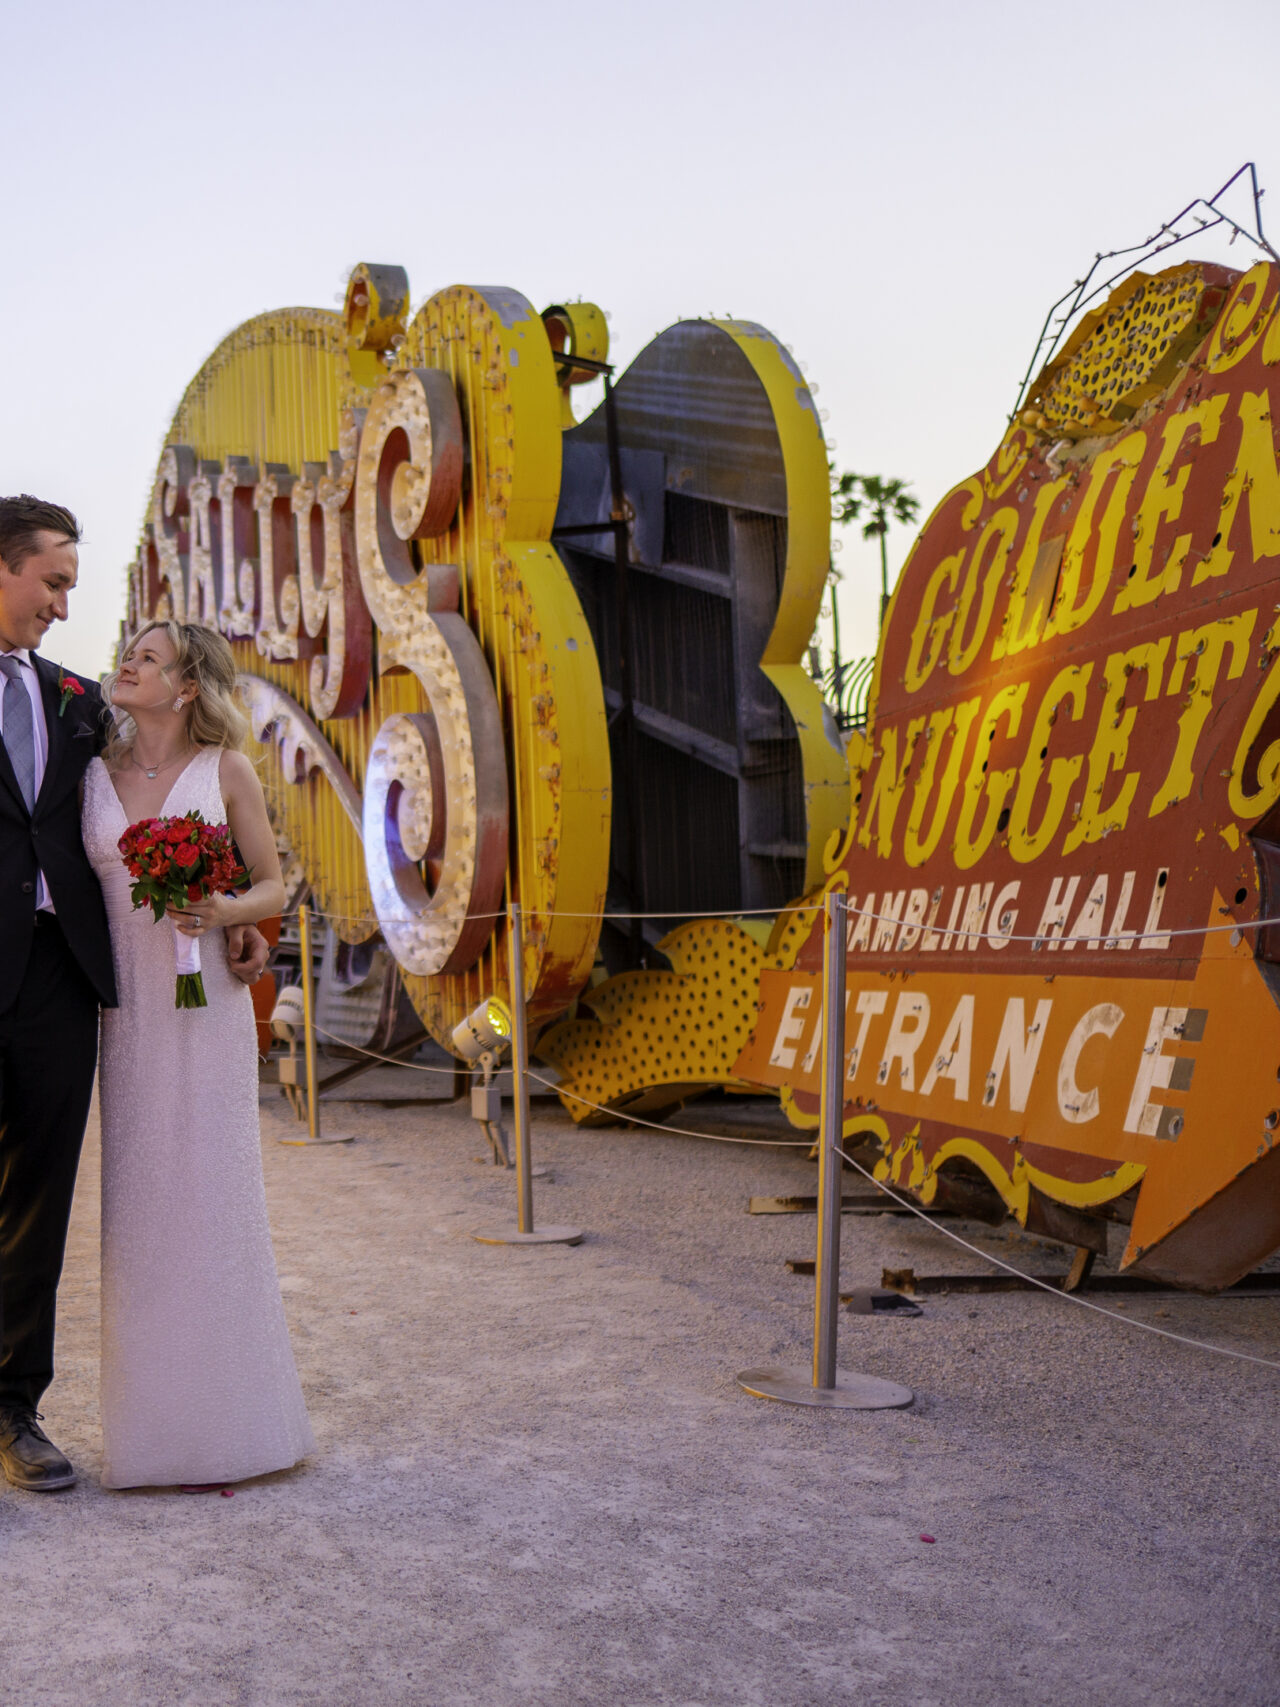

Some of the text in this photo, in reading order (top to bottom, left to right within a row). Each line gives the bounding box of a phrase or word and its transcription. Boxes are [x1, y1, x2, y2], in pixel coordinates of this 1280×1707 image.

[904, 388, 1280, 694] GOLDEN
[857, 608, 1260, 870] NUGGET
[1031, 867, 1172, 952] HALL
